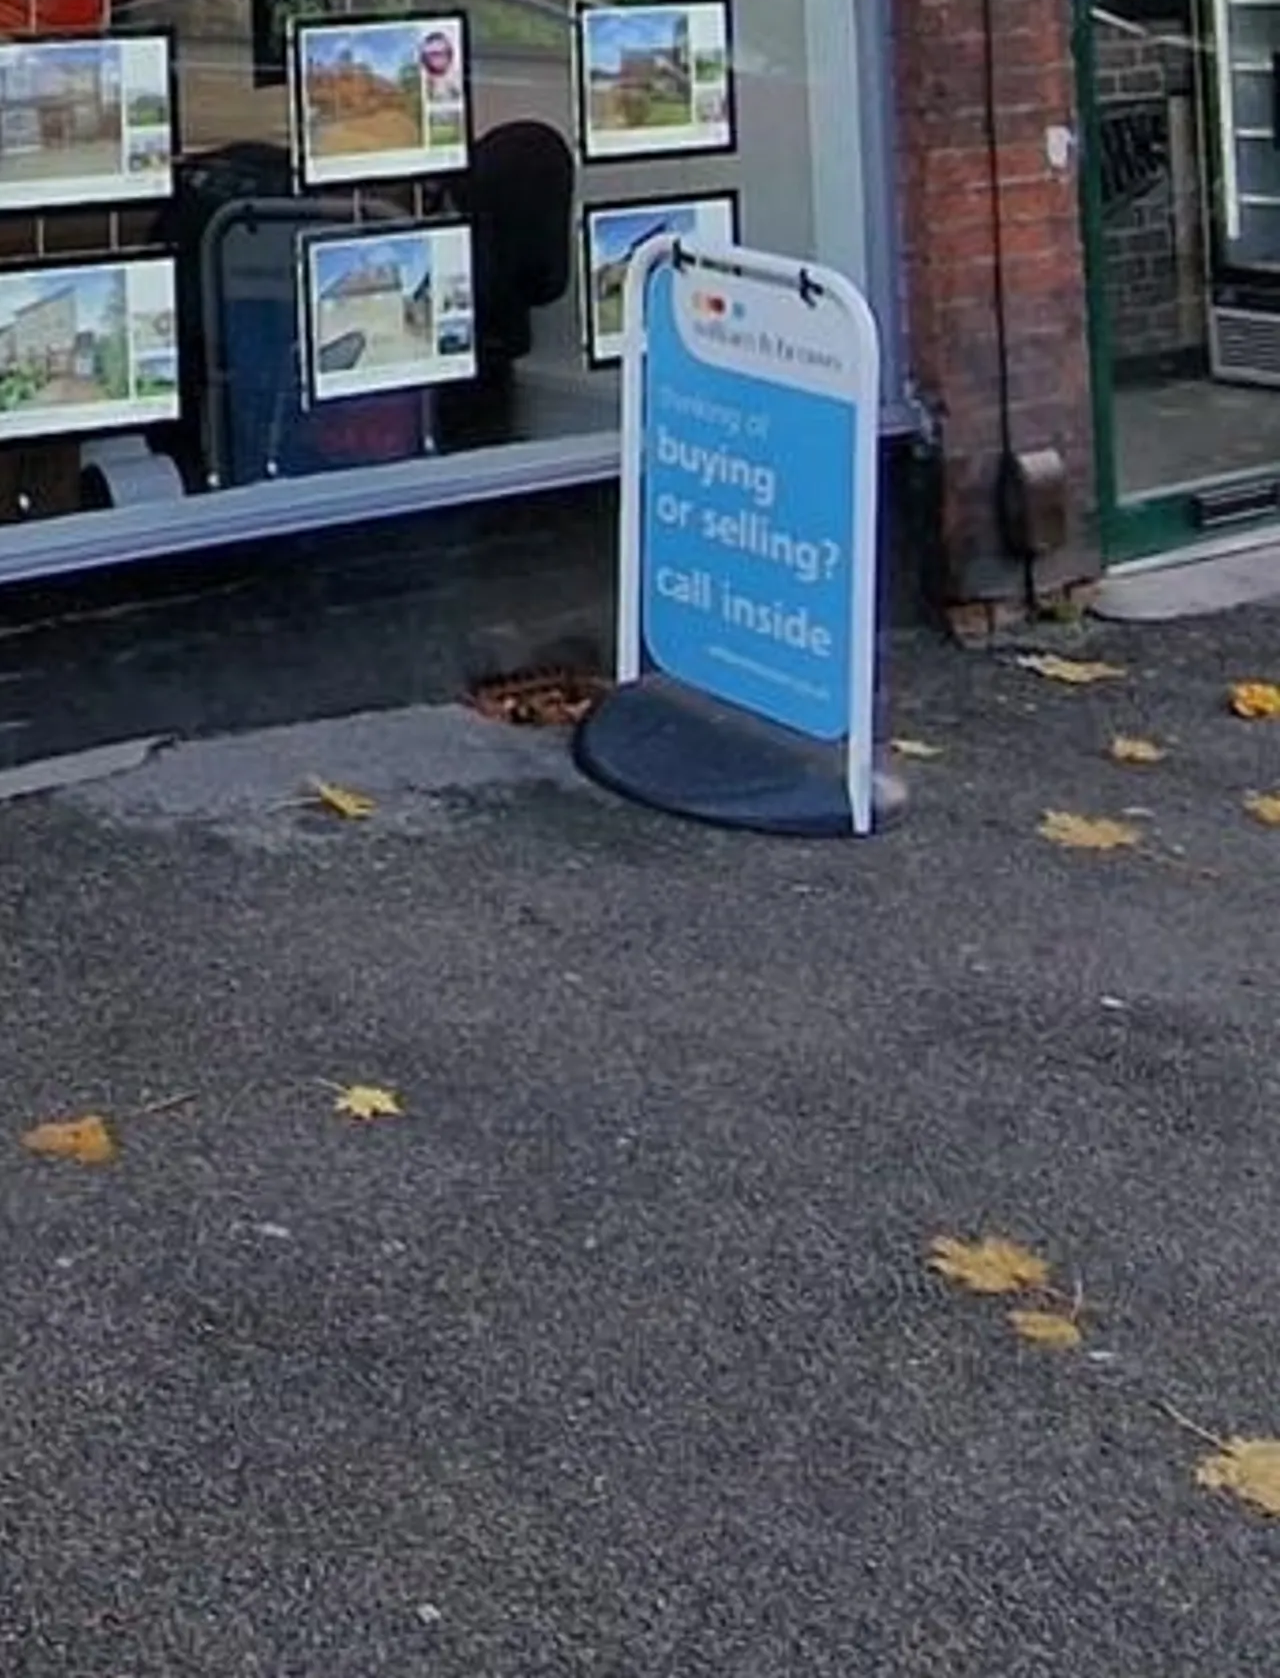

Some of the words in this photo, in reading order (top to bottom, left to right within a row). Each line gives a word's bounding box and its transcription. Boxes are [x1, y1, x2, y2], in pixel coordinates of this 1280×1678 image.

[656, 425, 775, 507] buying
[656, 493, 693, 528] or
[702, 511, 840, 582] selling?
[656, 566, 712, 610] call
[721, 575, 832, 657] inside
